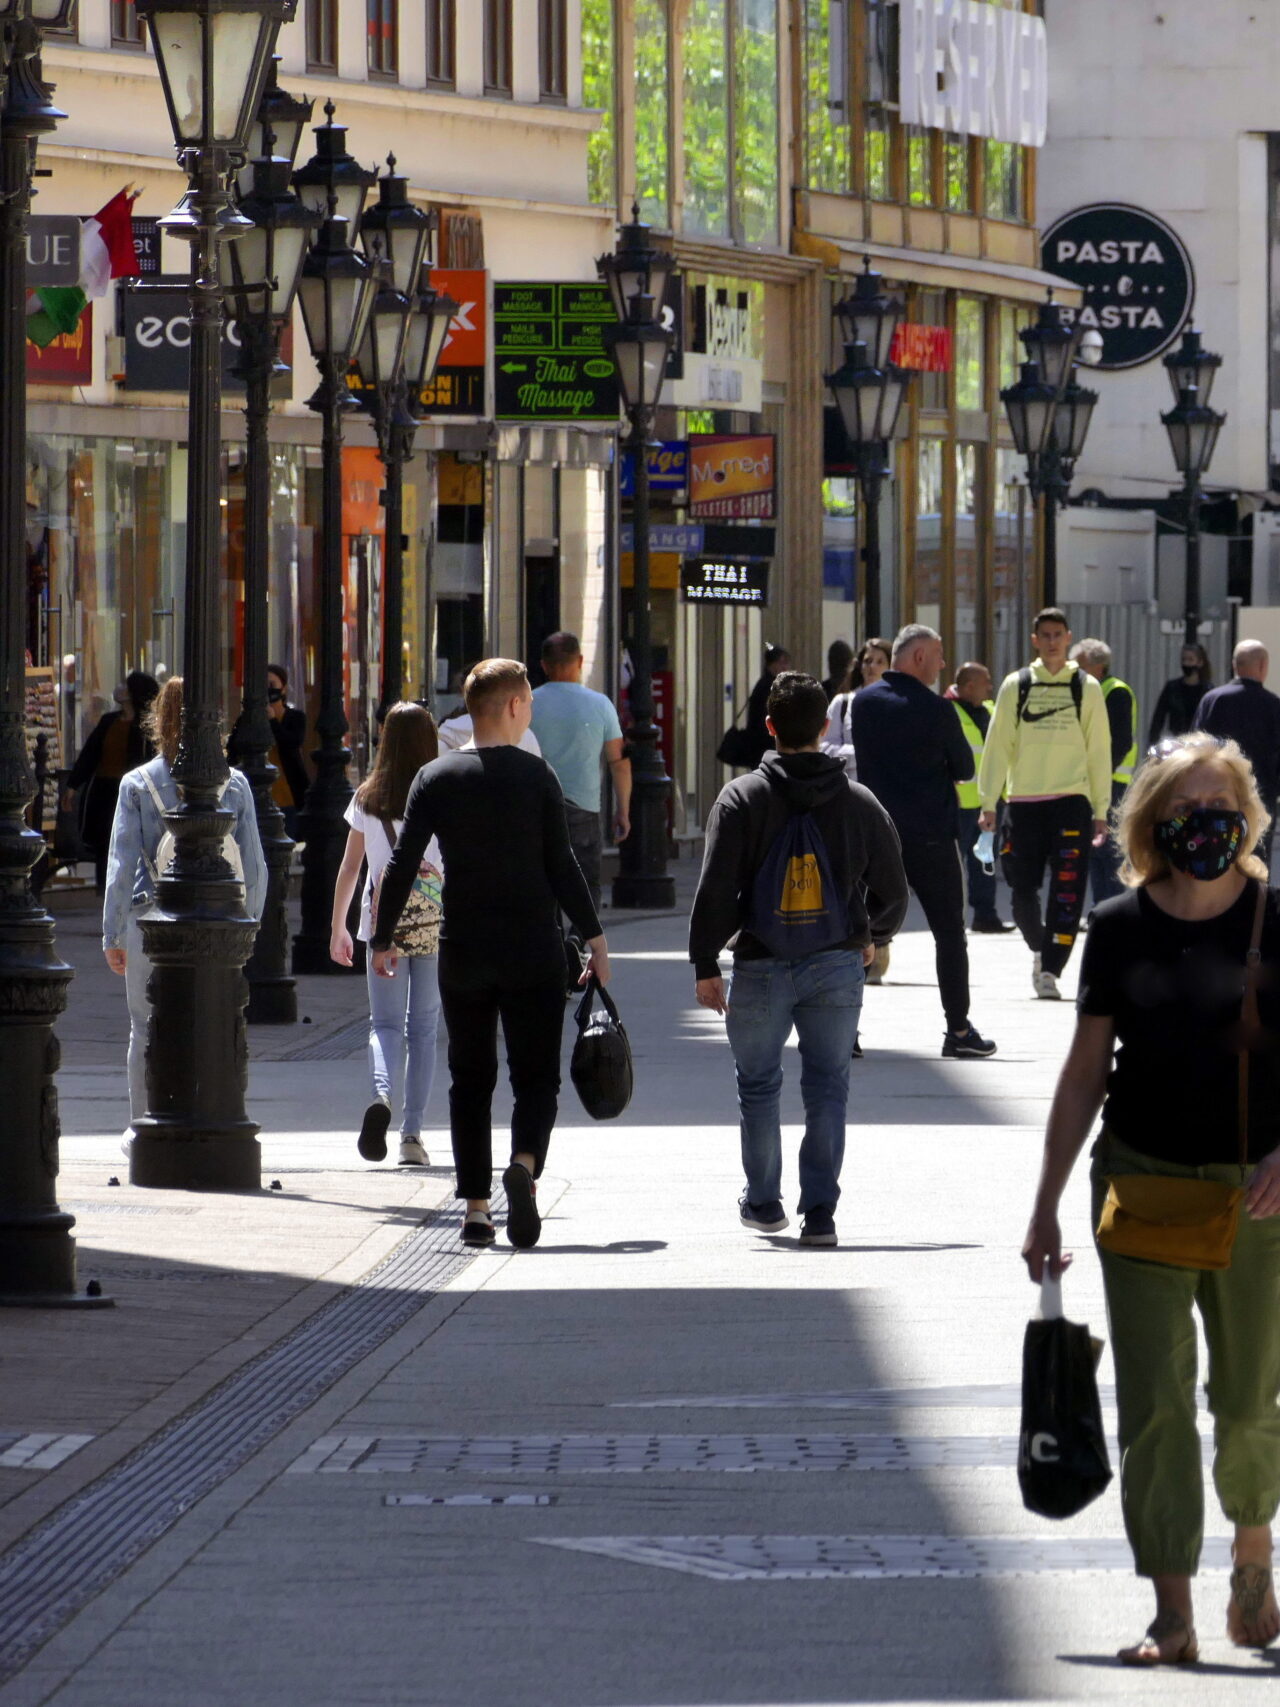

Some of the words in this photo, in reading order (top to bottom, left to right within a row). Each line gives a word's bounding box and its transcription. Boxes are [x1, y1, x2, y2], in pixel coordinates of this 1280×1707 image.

[900, 0, 1048, 147] RESERVED
[27, 235, 71, 265] UE
[1057, 241, 1164, 264] PASTA
[1058, 306, 1164, 329] BASTA
[535, 356, 577, 383] Thai
[517, 384, 595, 415] Massage
[647, 451, 686, 474] nge
[620, 532, 700, 546] CANGE
[702, 564, 748, 583] THAI
